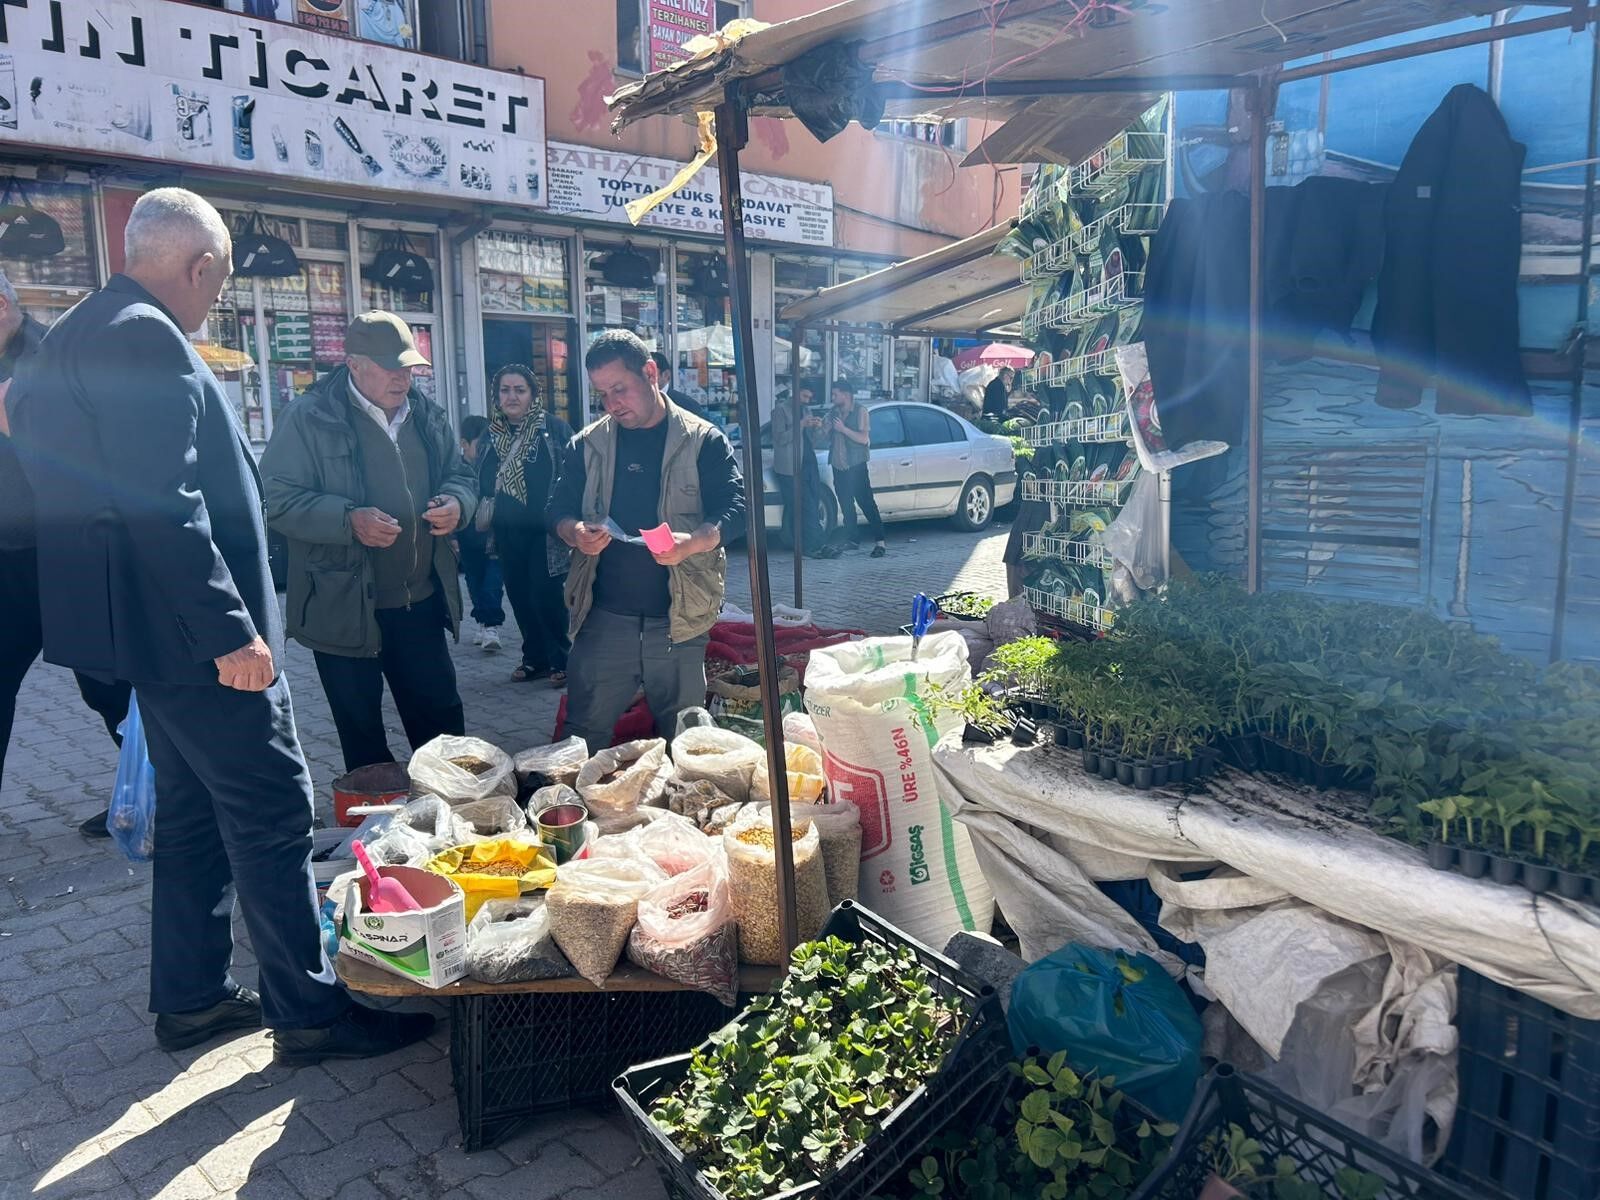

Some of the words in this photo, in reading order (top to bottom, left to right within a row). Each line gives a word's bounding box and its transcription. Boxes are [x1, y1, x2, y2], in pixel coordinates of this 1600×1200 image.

[180, 27, 529, 133] TİCARET
[672, 187, 714, 204] LÜKS
[640, 214, 708, 230] EL:210
[692, 206, 704, 218] &
[709, 209, 786, 228] KIASİYE
[891, 728, 912, 770] %46N
[901, 772, 918, 803] ÜRE
